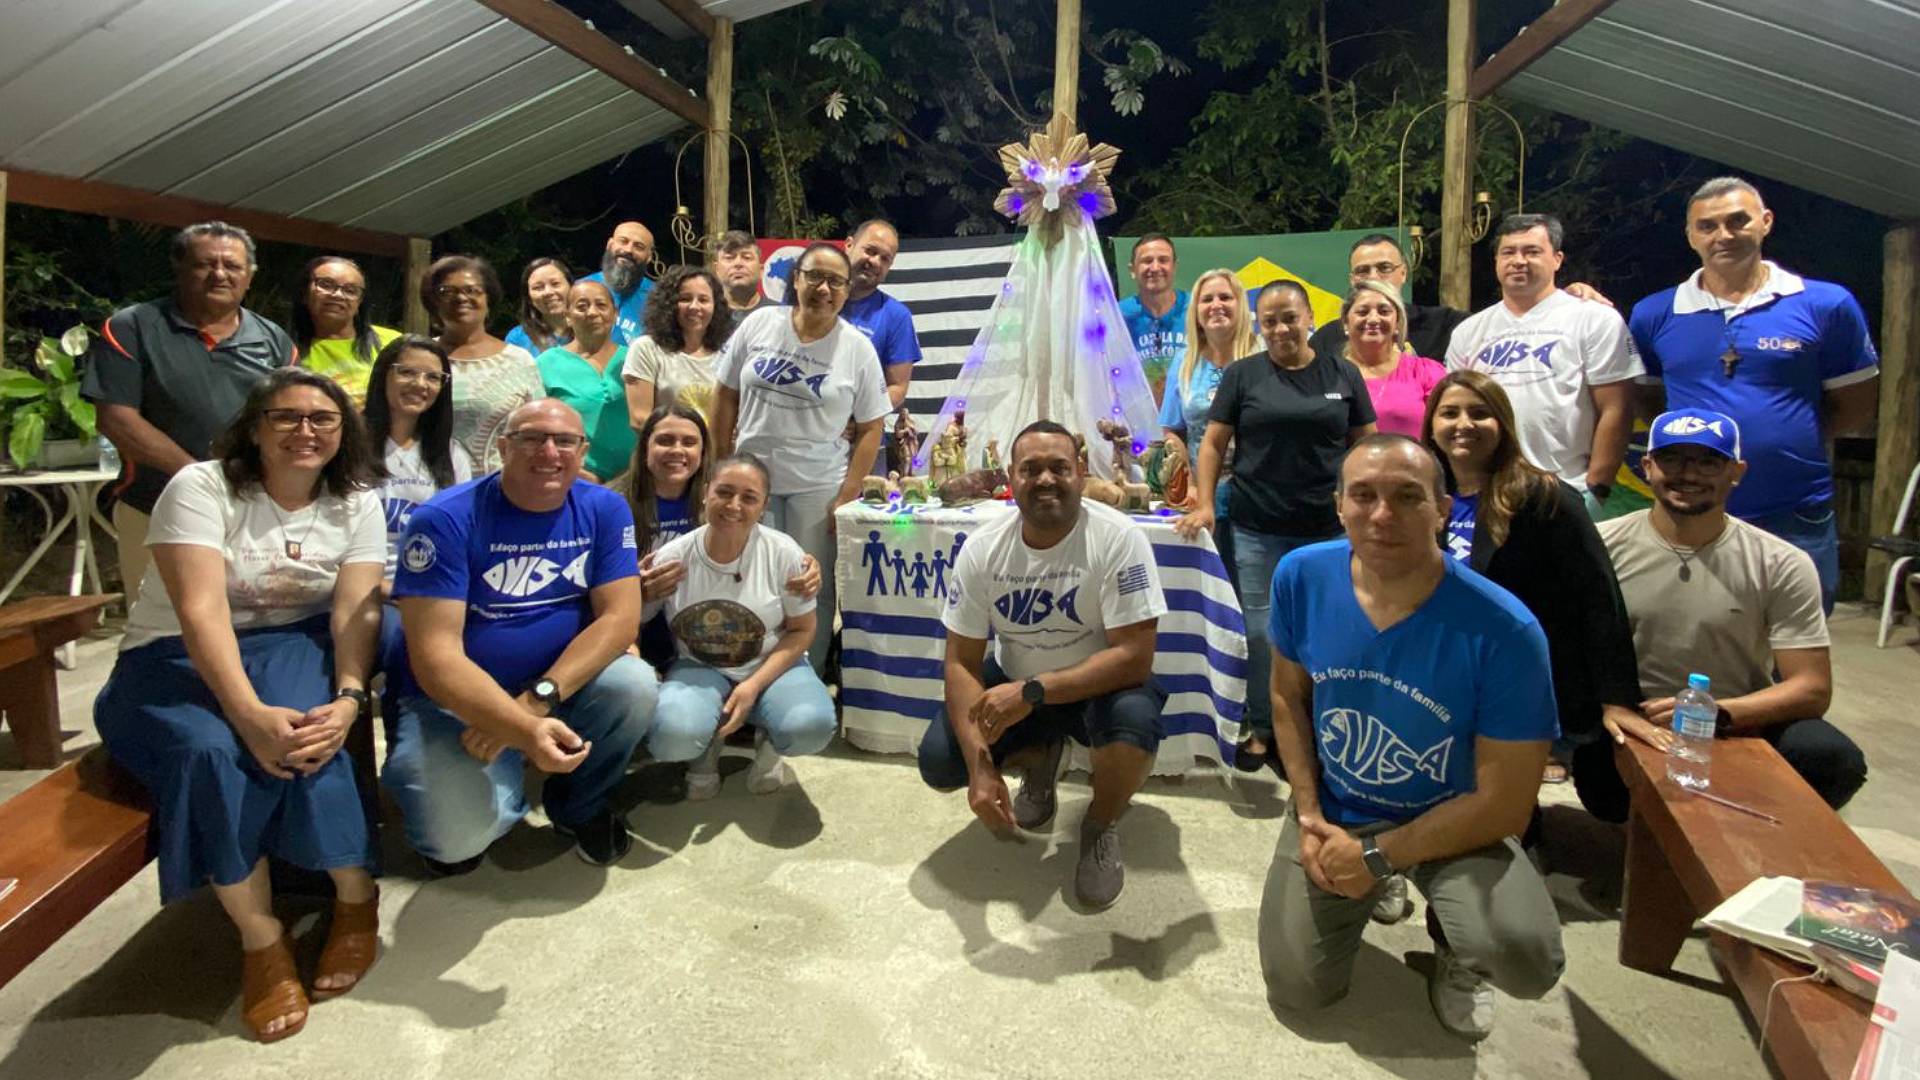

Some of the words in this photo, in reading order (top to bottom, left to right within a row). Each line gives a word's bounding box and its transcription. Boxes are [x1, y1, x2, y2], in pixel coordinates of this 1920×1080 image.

[1138, 331, 1174, 347] CAPLA
[1757, 337, 1780, 350] 50
[546, 540, 559, 549] da
[1312, 671, 1327, 684] Eu
[1327, 666, 1355, 681] faço
[1358, 669, 1392, 686] parte
[1393, 680, 1409, 695] da
